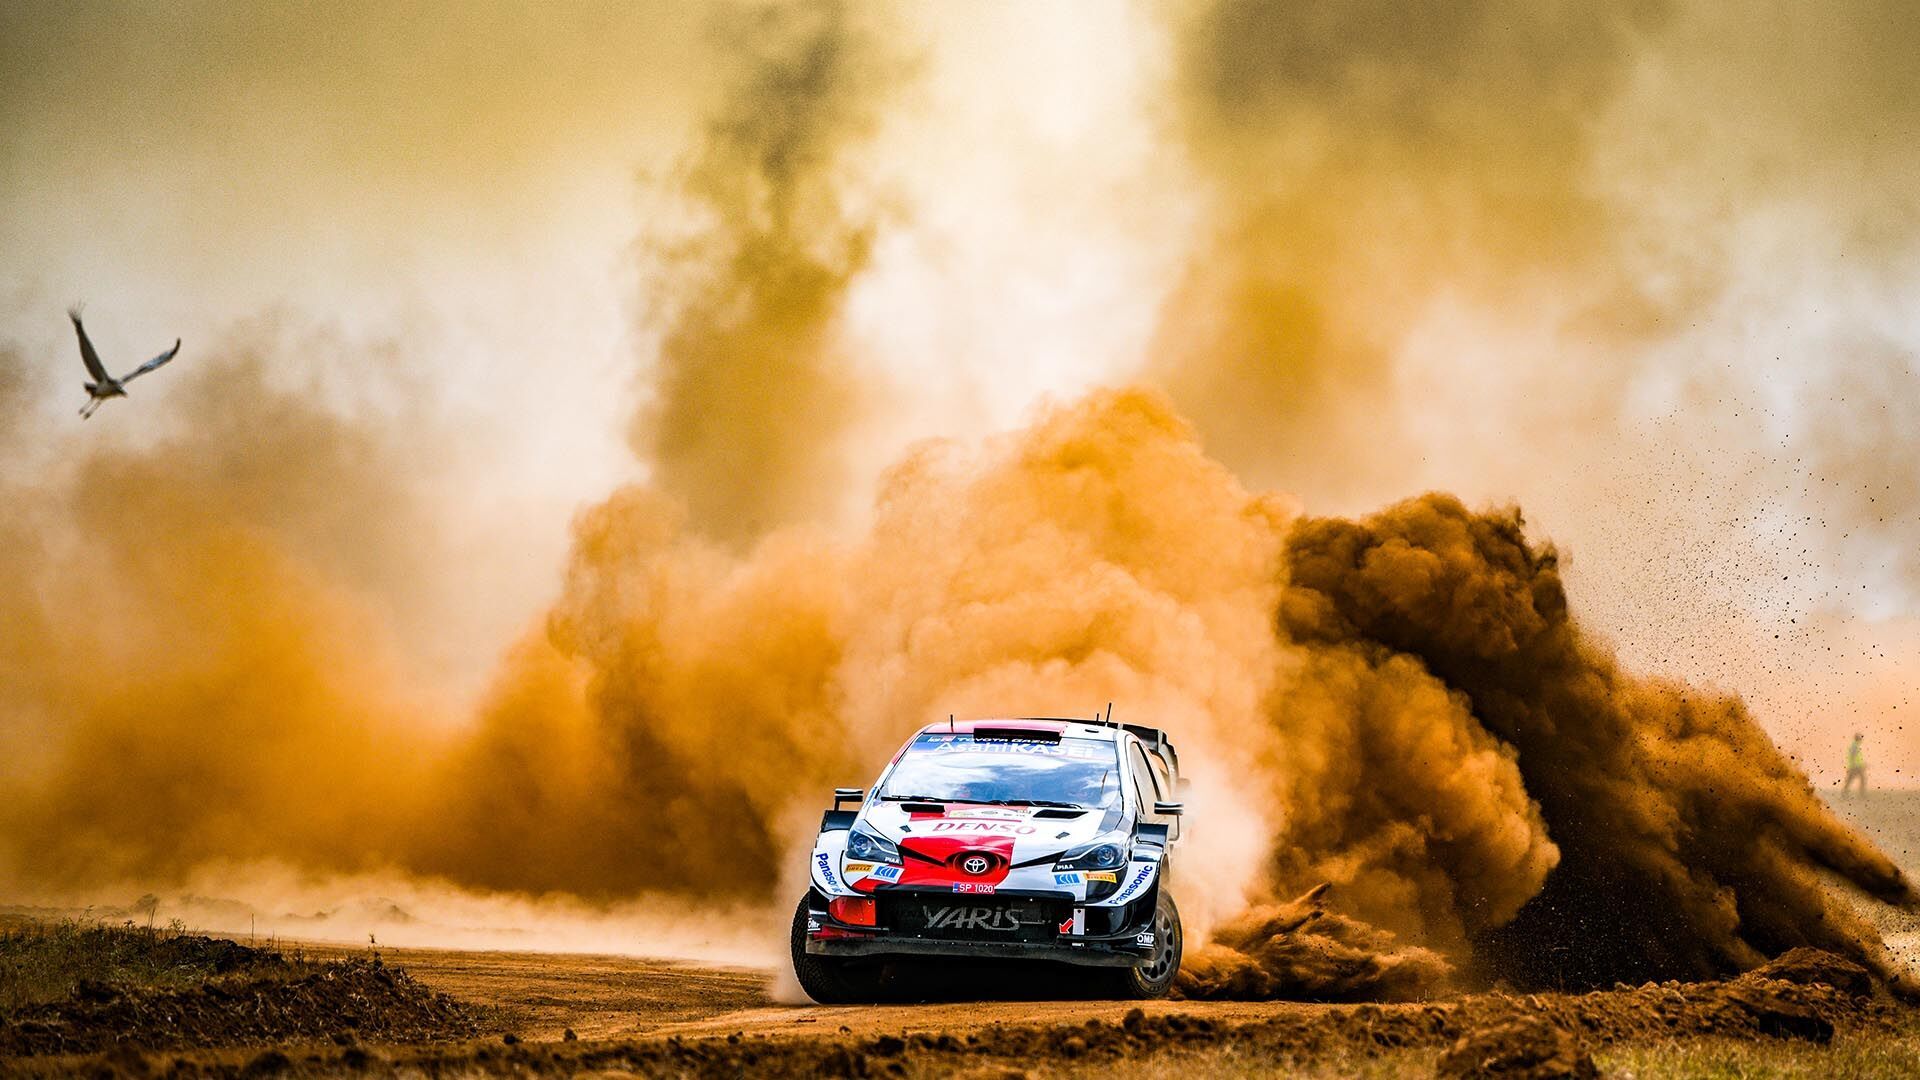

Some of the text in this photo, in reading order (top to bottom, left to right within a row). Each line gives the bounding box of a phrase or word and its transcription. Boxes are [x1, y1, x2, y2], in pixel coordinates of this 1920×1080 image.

[932, 822, 1037, 835] DENSO
[960, 884, 994, 893] SP 1020
[1107, 864, 1153, 905] Panasonic
[1137, 934, 1155, 944] OMP
